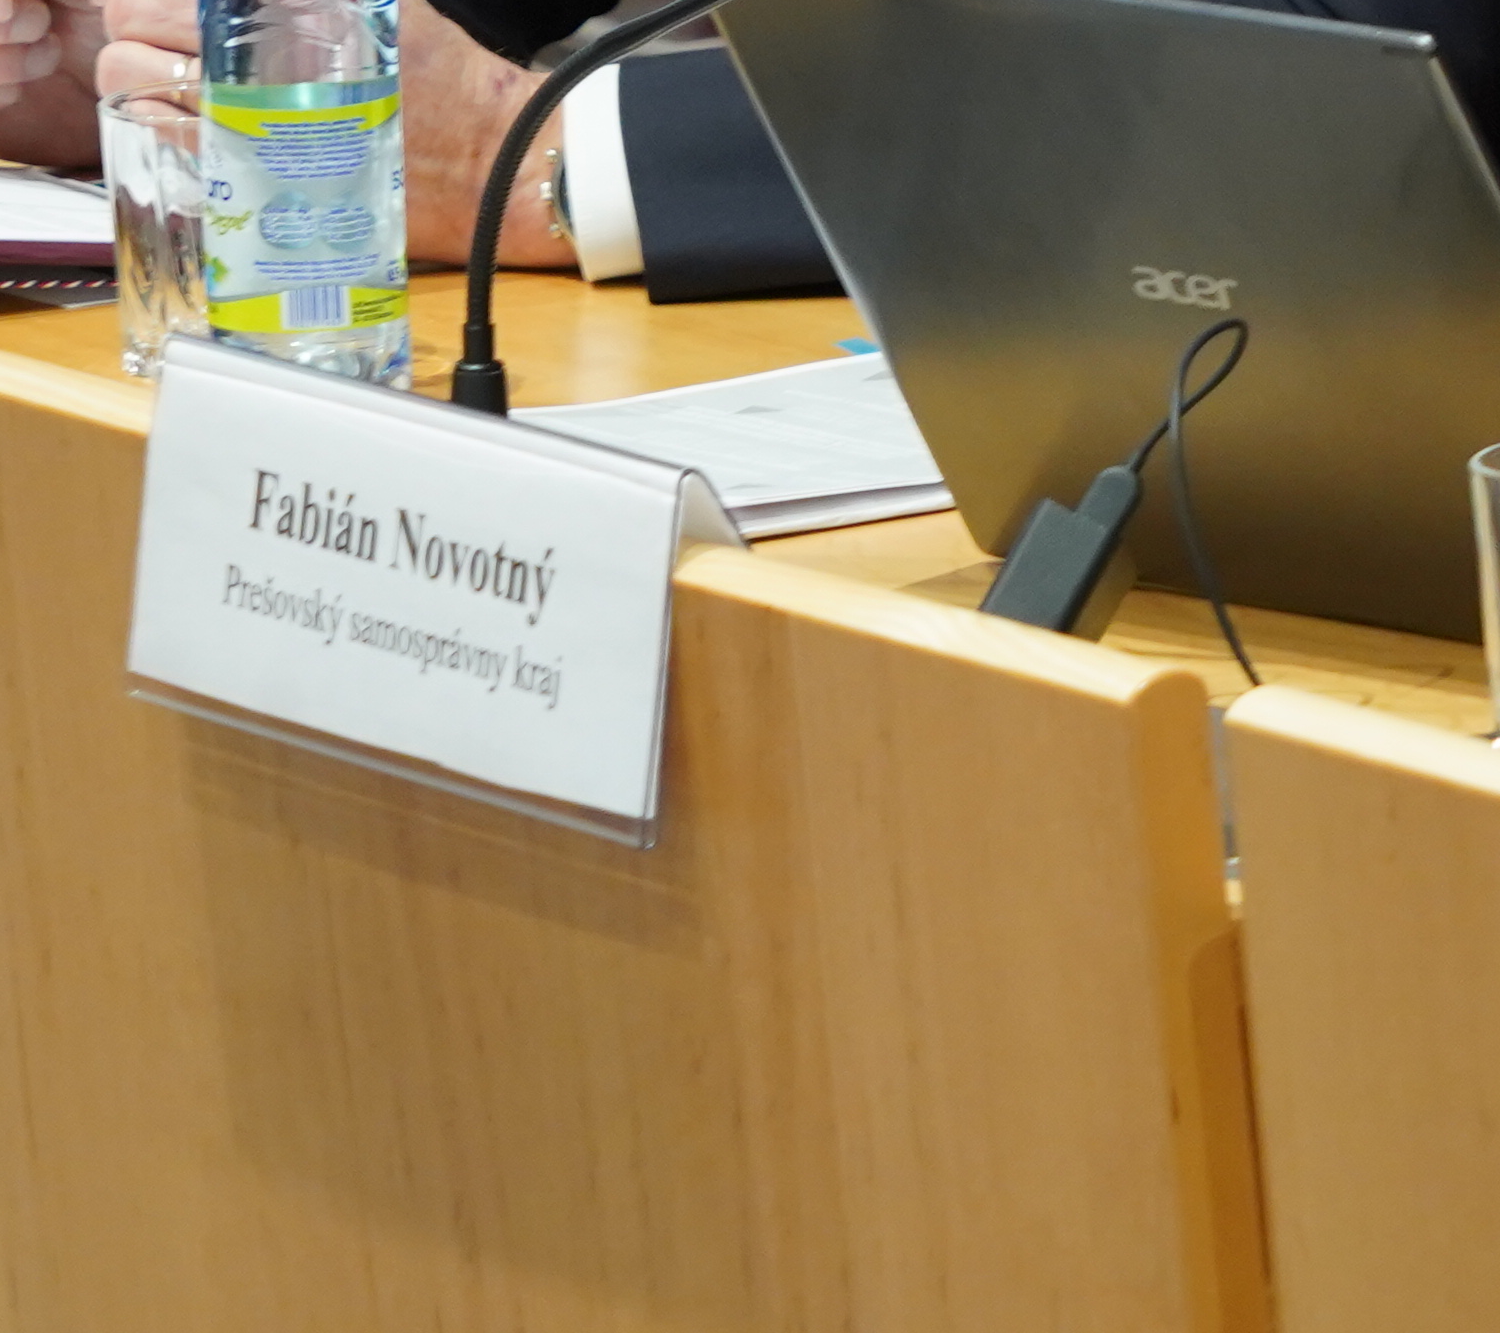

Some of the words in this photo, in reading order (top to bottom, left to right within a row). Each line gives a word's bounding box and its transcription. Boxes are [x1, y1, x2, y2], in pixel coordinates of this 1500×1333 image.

[1131, 265, 1239, 312] acer
[248, 468, 380, 562] Fabián
[390, 507, 555, 625] Novotný
[222, 563, 343, 645] Prešovský
[348, 612, 507, 692] samosprávny
[513, 644, 563, 710] kraj
